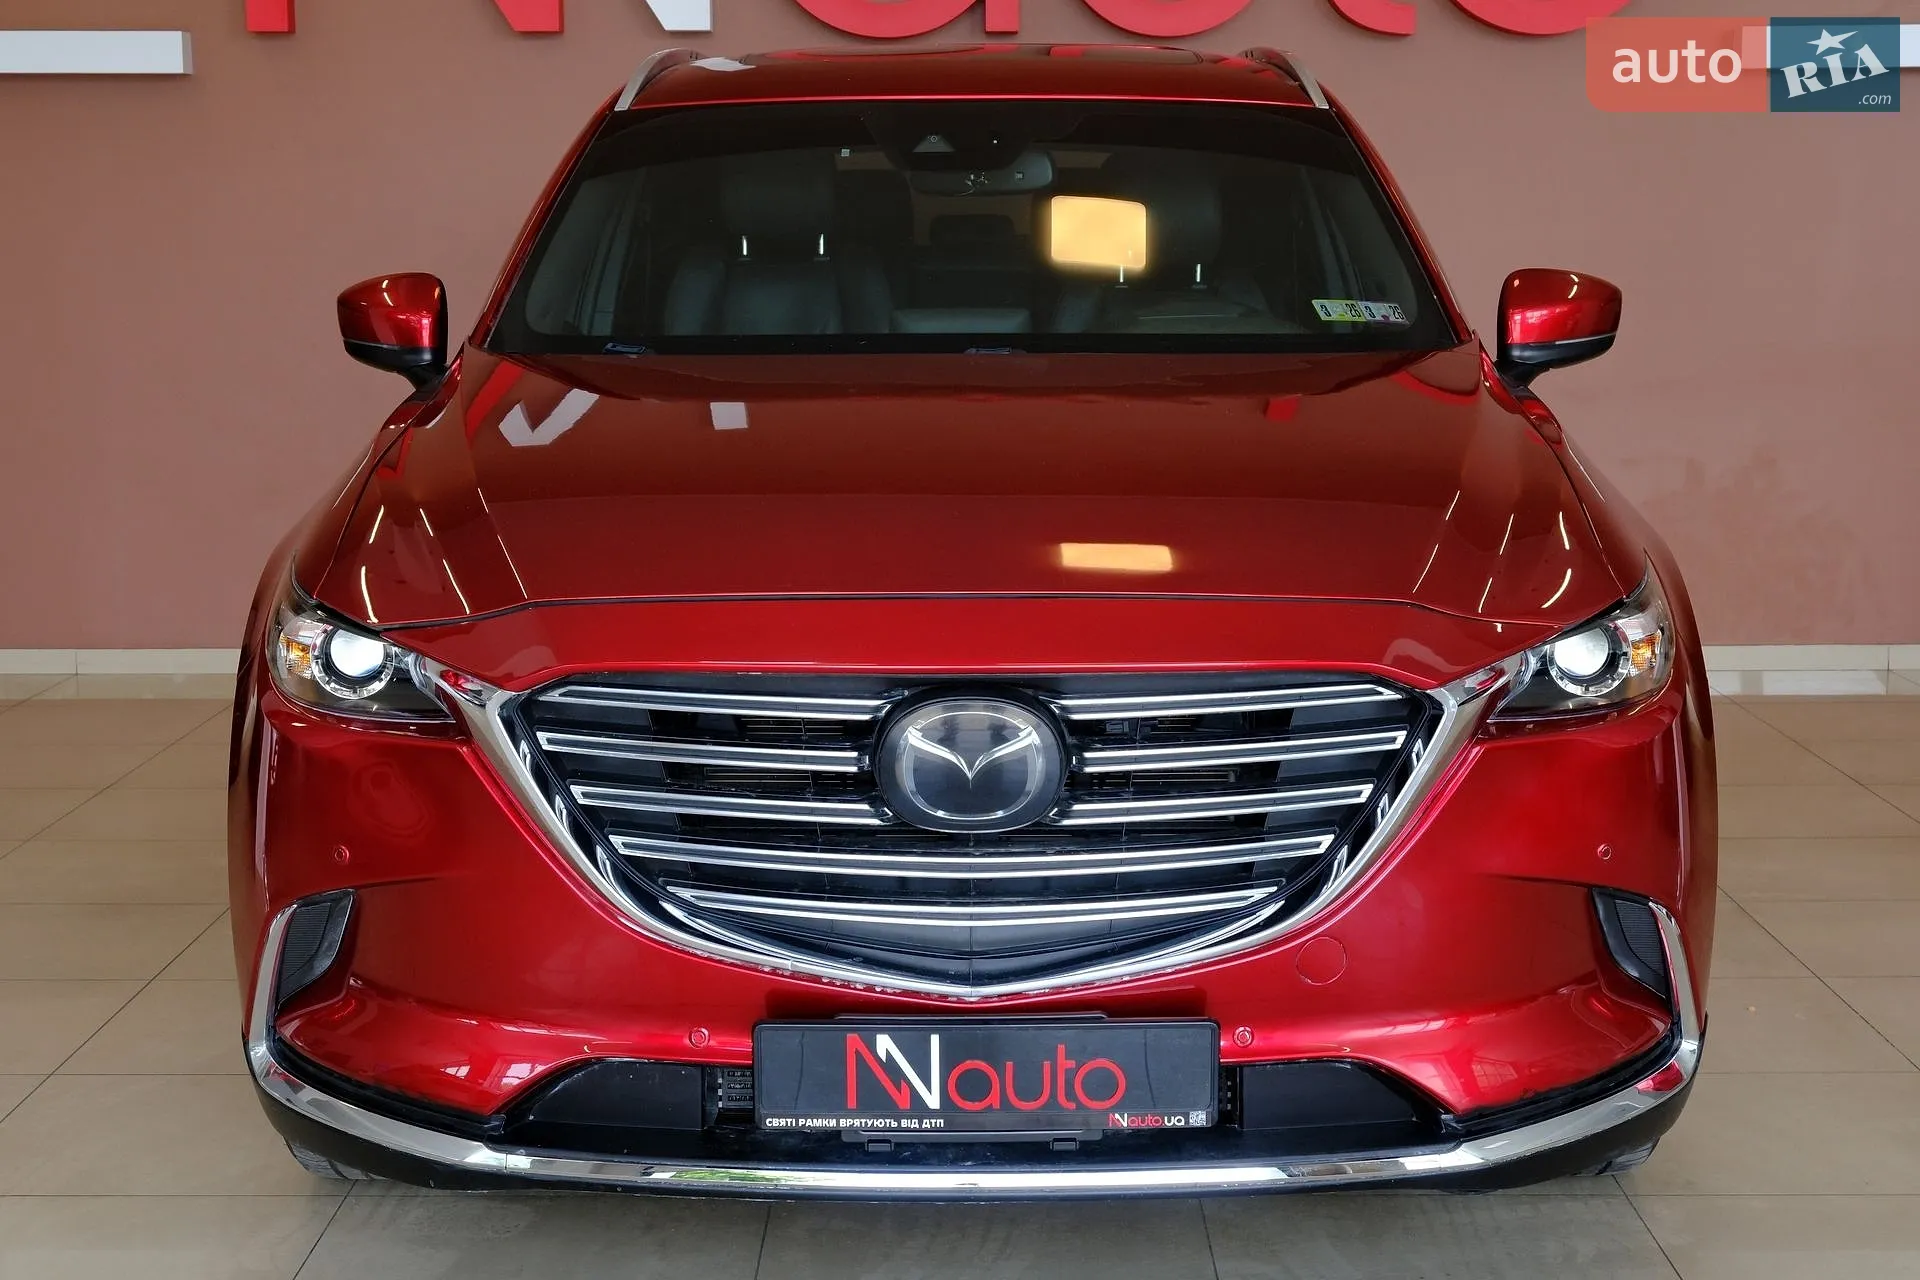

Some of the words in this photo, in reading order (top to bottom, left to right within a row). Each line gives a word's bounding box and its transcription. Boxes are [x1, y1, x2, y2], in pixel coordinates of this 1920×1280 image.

[1320, 304, 1332, 317] 3
[1345, 303, 1361, 318] 26
[1364, 305, 1376, 319] 3
[1388, 305, 1405, 320] 26
[765, 1118, 796, 1127] СВЯТІ
[799, 1118, 837, 1127] РАМКИ
[839, 1118, 898, 1128] ВРЯТУЮТЬ
[901, 1119, 919, 1129] ВІД
[922, 1119, 945, 1129] ДТП
